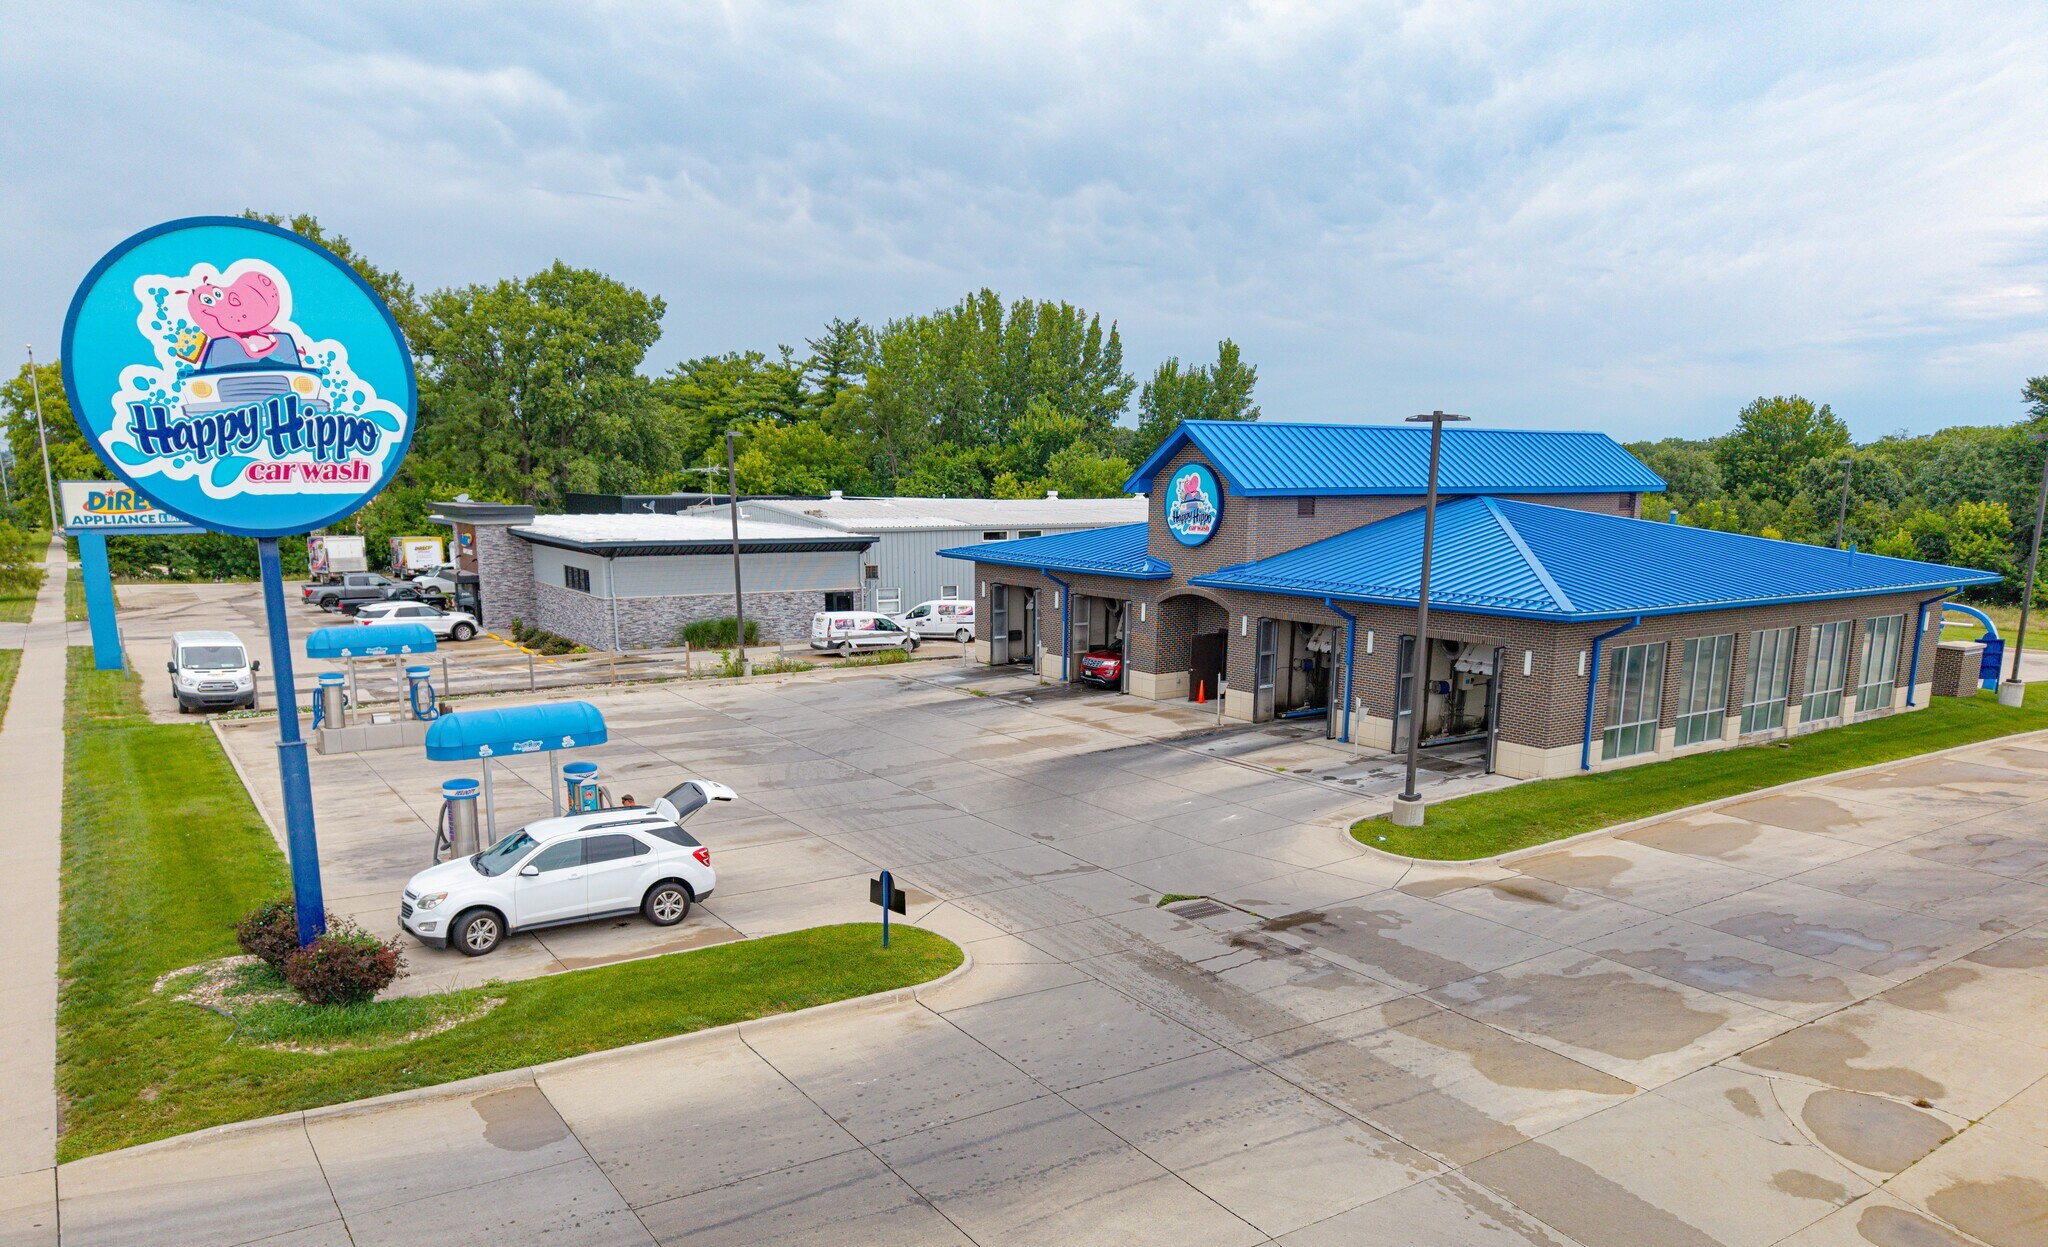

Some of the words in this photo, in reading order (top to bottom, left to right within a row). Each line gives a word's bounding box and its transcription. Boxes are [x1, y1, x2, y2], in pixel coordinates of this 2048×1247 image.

[130, 404, 258, 460] Happy
[264, 394, 379, 461] Hippo
[247, 463, 297, 481] car
[301, 460, 370, 481] wash
[72, 514, 156, 525] APPLIANCE
